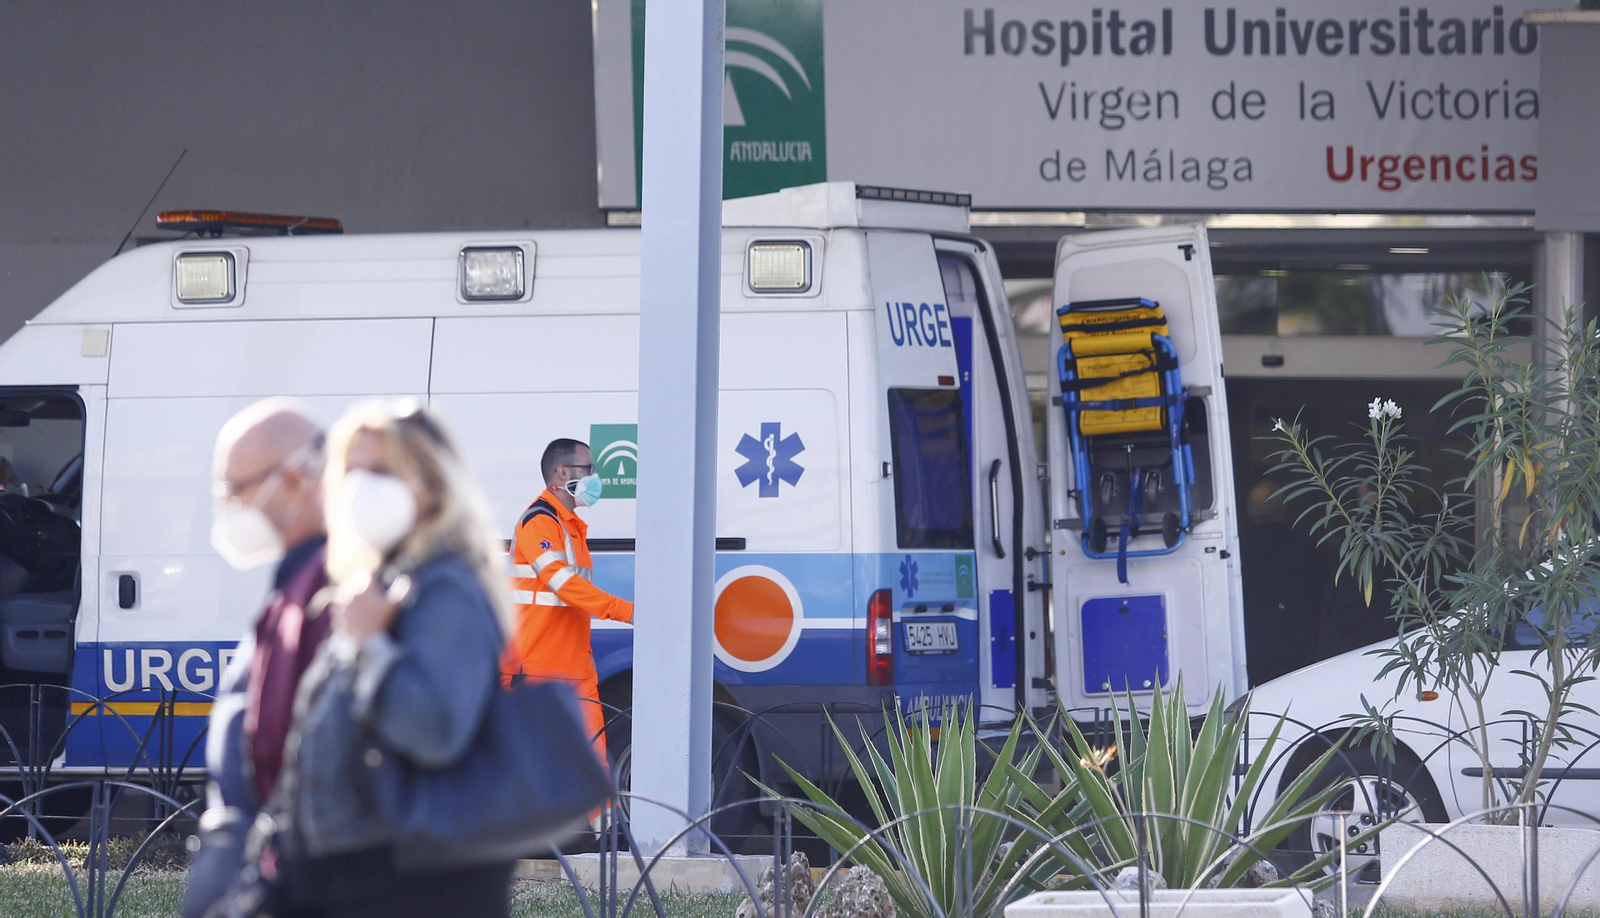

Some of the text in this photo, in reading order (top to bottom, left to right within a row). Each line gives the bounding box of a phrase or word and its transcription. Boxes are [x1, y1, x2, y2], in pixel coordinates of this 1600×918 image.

[963, 6, 1538, 66] Hospital Universitario
[1038, 79, 1540, 131] Virgen de la Victoria
[1039, 148, 1253, 191] de Málaga
[1326, 144, 1538, 192] Urgencias
[885, 302, 952, 348] URGE
[908, 625, 955, 647] 5425 HVJ
